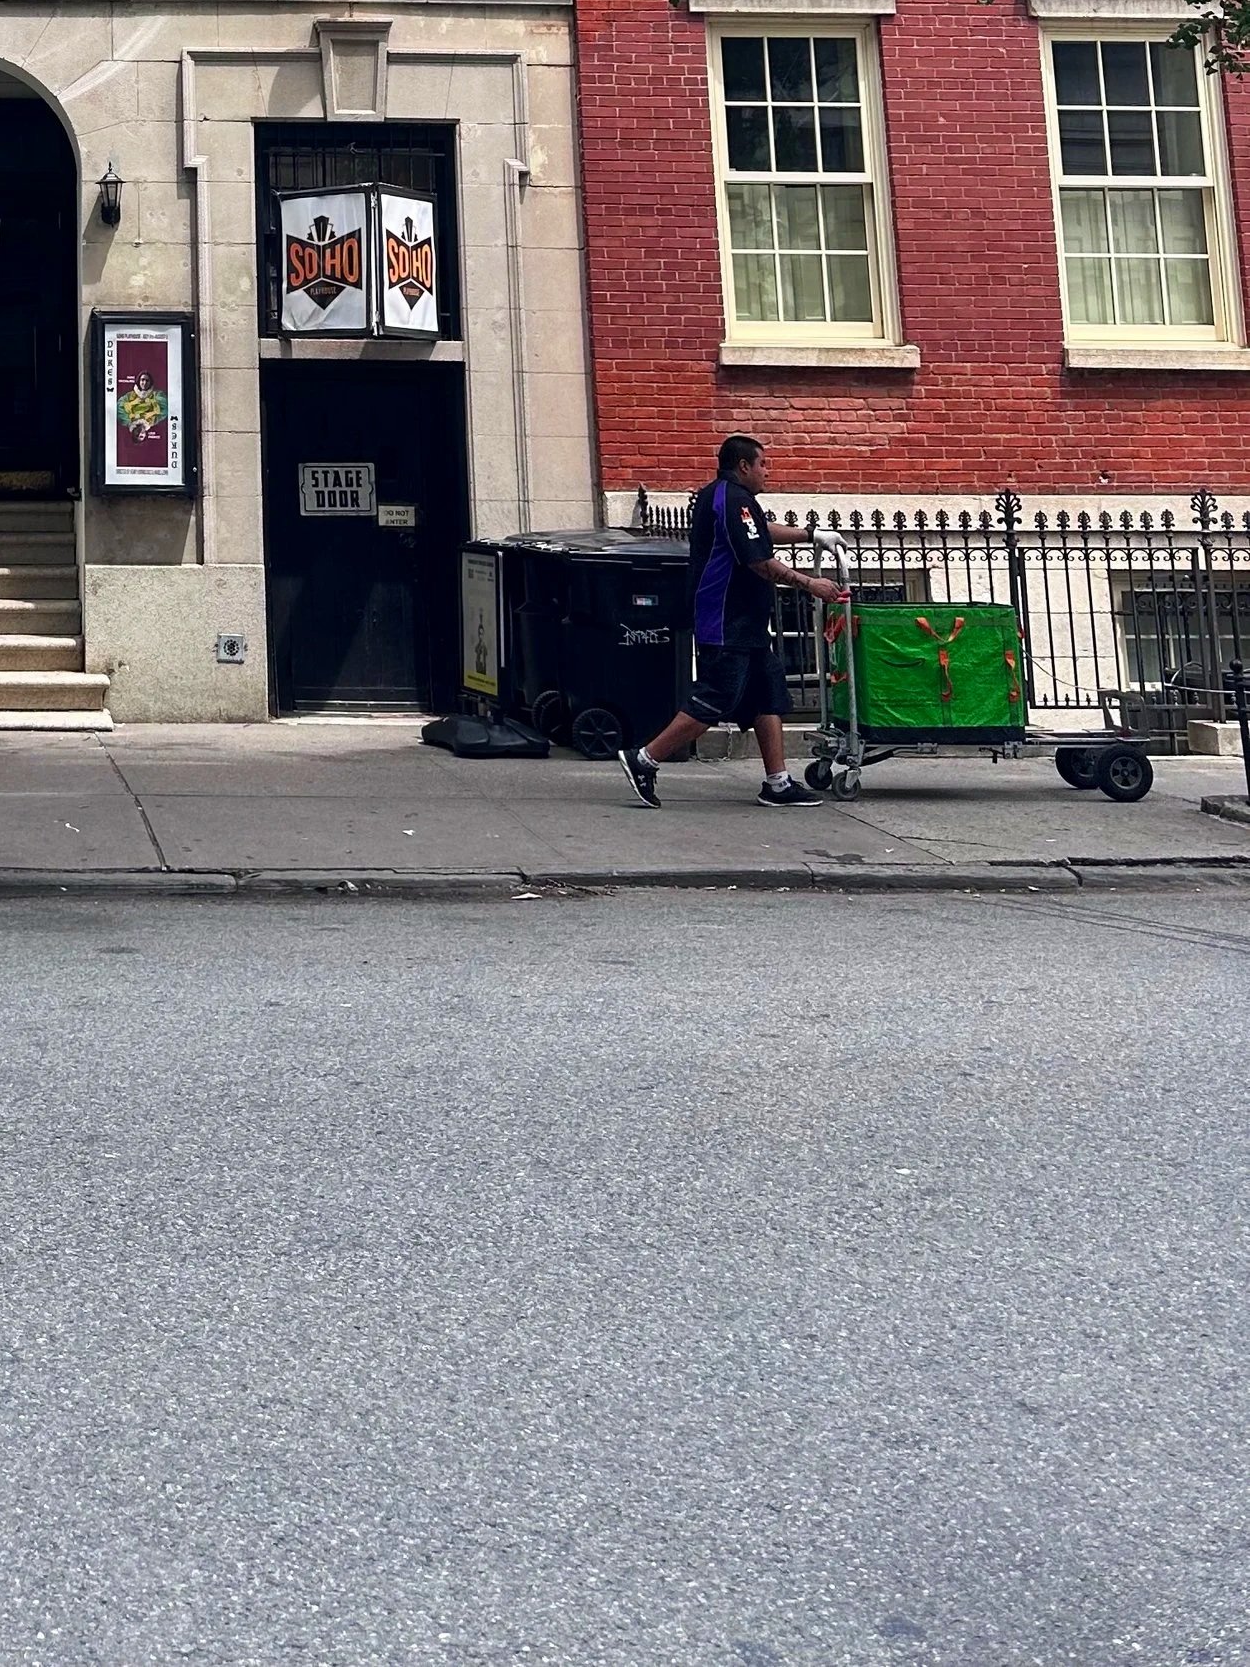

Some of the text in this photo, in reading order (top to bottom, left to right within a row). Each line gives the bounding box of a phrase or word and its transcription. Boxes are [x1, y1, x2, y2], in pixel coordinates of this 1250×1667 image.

[289, 237, 359, 287] SOHO
[387, 237, 432, 288] SOHO
[310, 286, 337, 295] PLAYHOUSE
[311, 470, 363, 488] STAGE
[315, 490, 360, 508] DOOR
